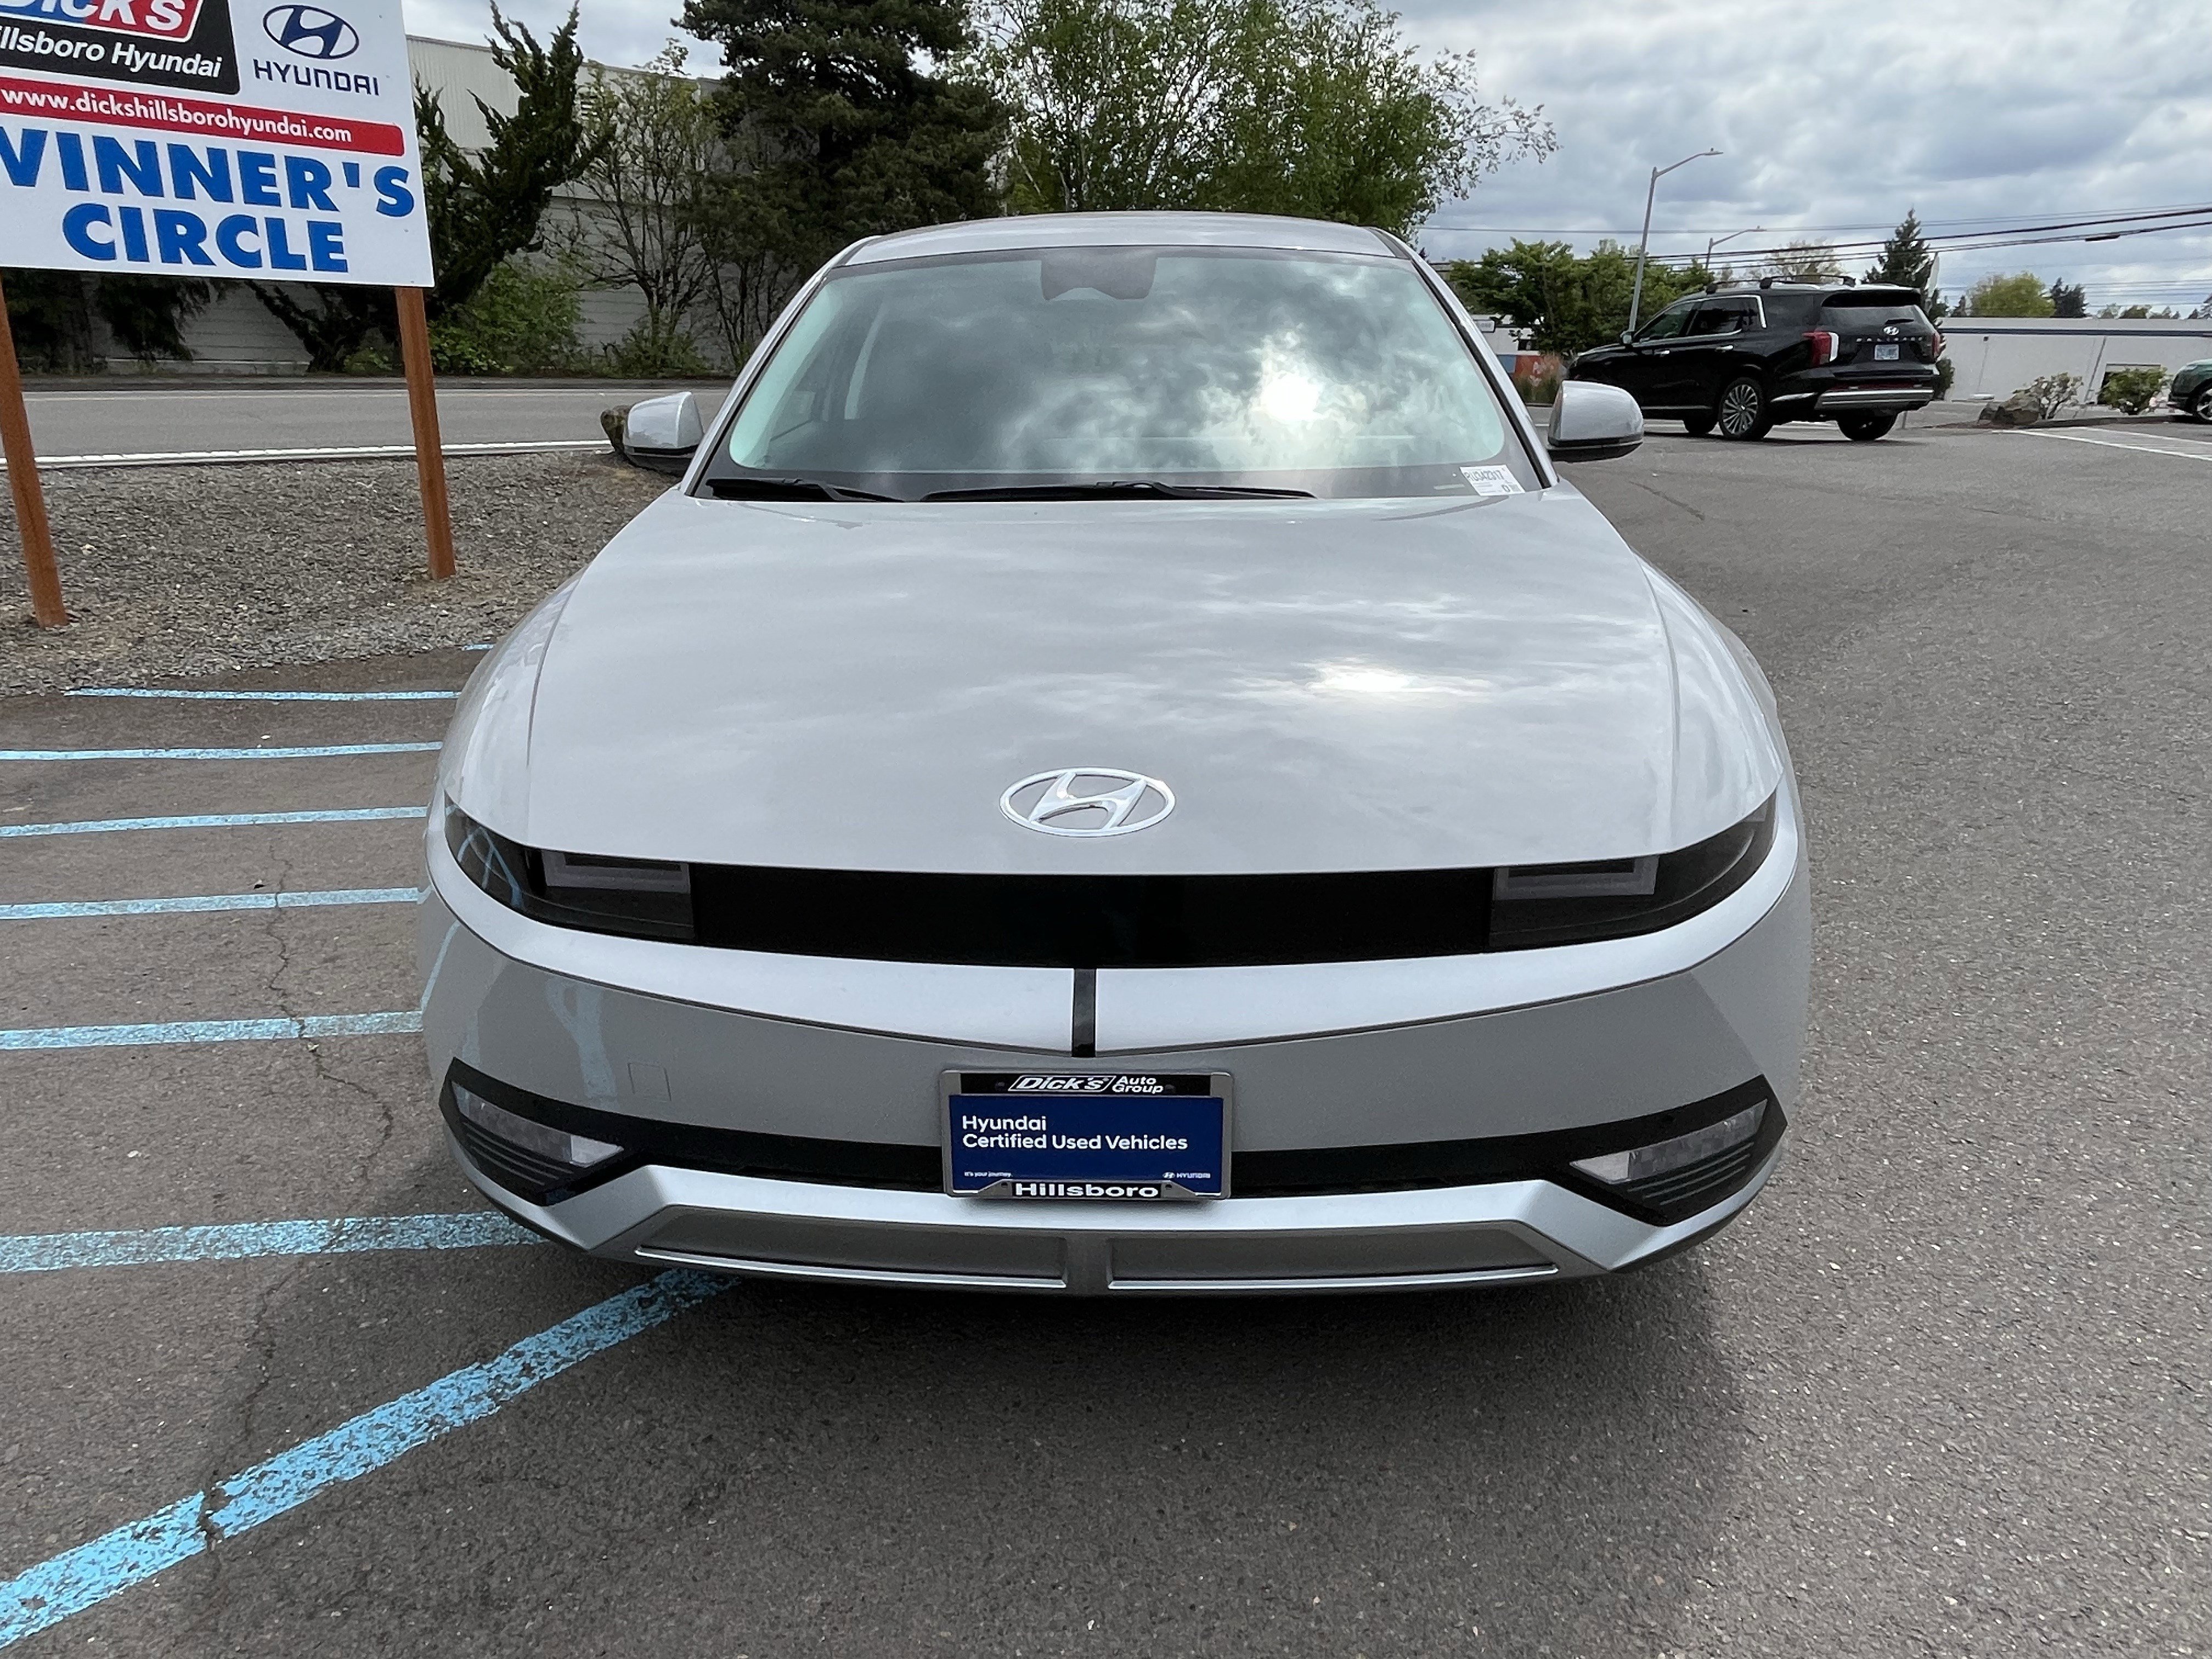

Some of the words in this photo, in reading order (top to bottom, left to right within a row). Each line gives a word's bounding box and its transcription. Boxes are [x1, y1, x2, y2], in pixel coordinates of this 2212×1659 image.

[0, 25, 105, 61] llsboro
[111, 42, 222, 78] Hyundai
[253, 59, 380, 96] HYUNDAI
[1, 88, 352, 143] www.dickshillsborohyundai.com
[63, 202, 348, 273] CIRCLE
[1112, 1084, 1164, 1094] Group
[1117, 1076, 1157, 1085] Auto
[962, 1115, 1047, 1133] Hyundai
[962, 1133, 1047, 1149] Certified
[1052, 1134, 1102, 1149] Used
[1105, 1134, 1188, 1150] Vehicles
[1015, 1183, 1159, 1197] Hillsboro
